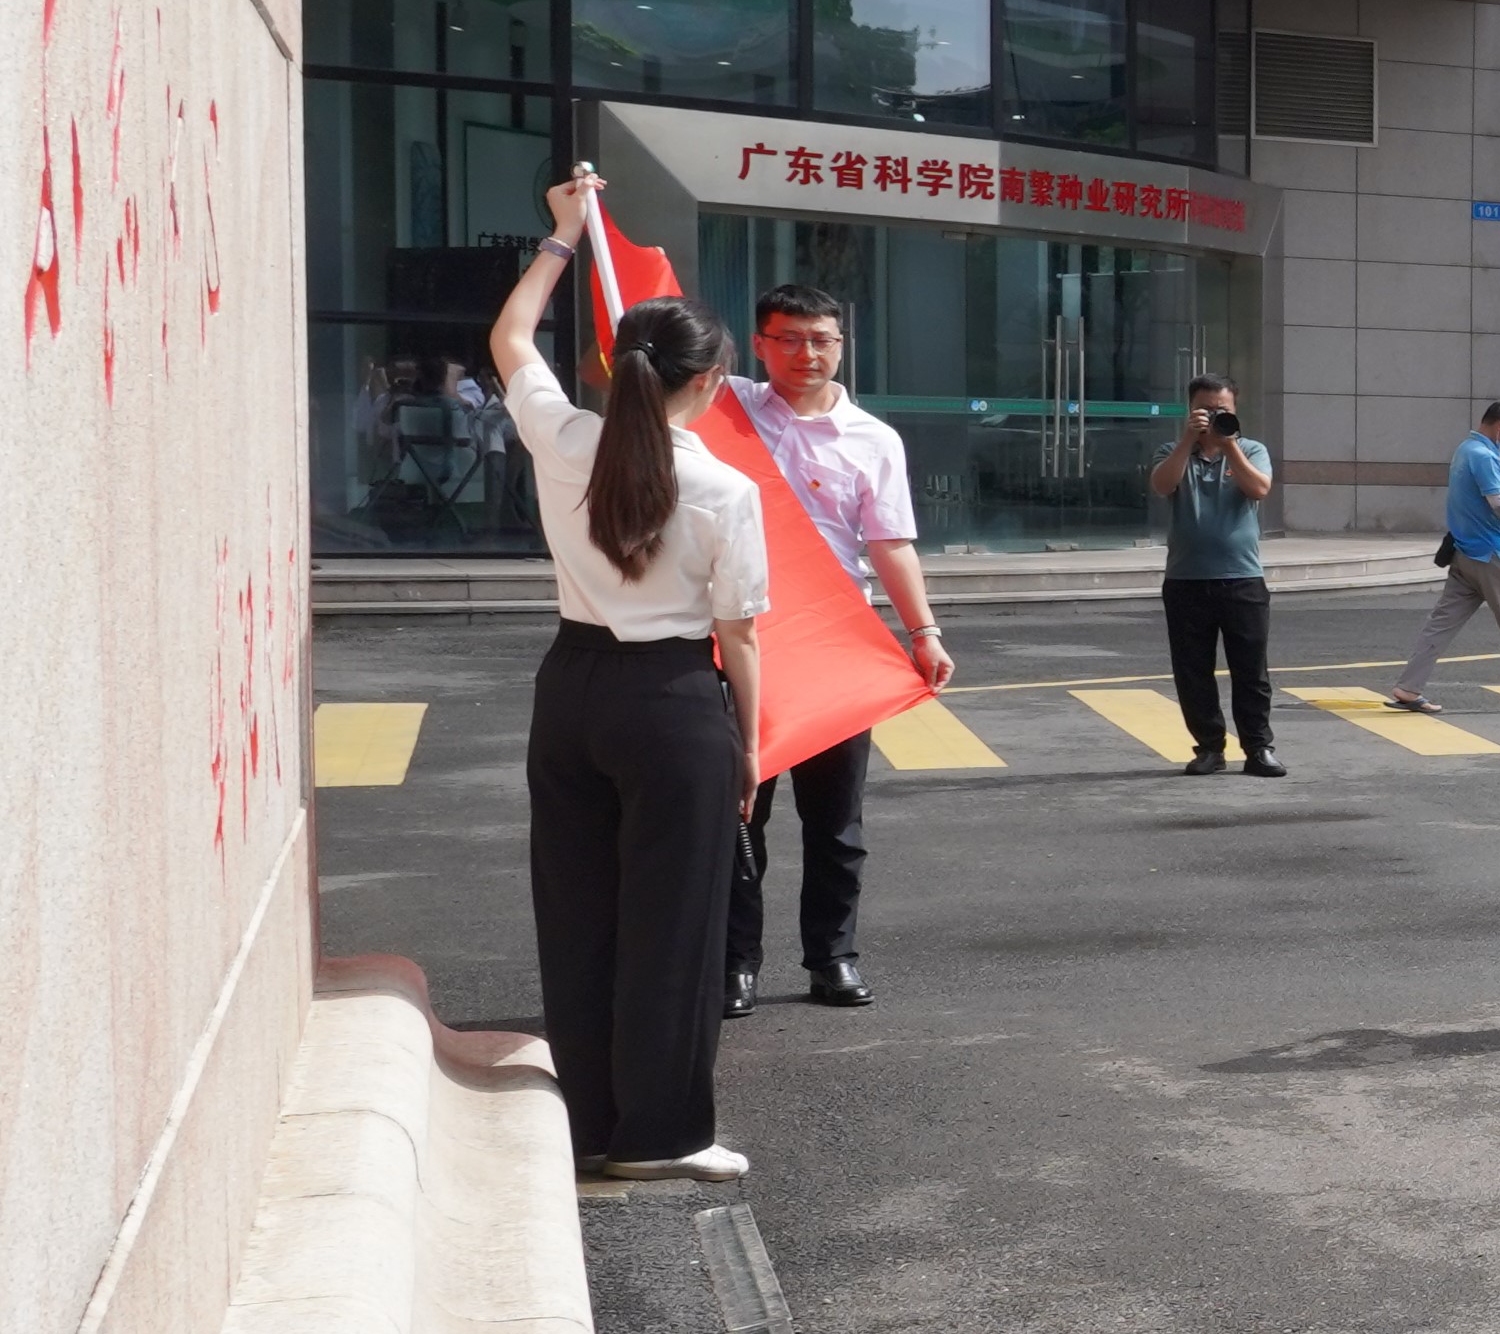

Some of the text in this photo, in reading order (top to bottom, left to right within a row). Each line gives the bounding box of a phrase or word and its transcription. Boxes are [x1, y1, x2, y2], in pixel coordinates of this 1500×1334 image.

[738, 142, 1188, 221] 广东省科学院南繁种业研究所
[1478, 206, 1499, 217] 101
